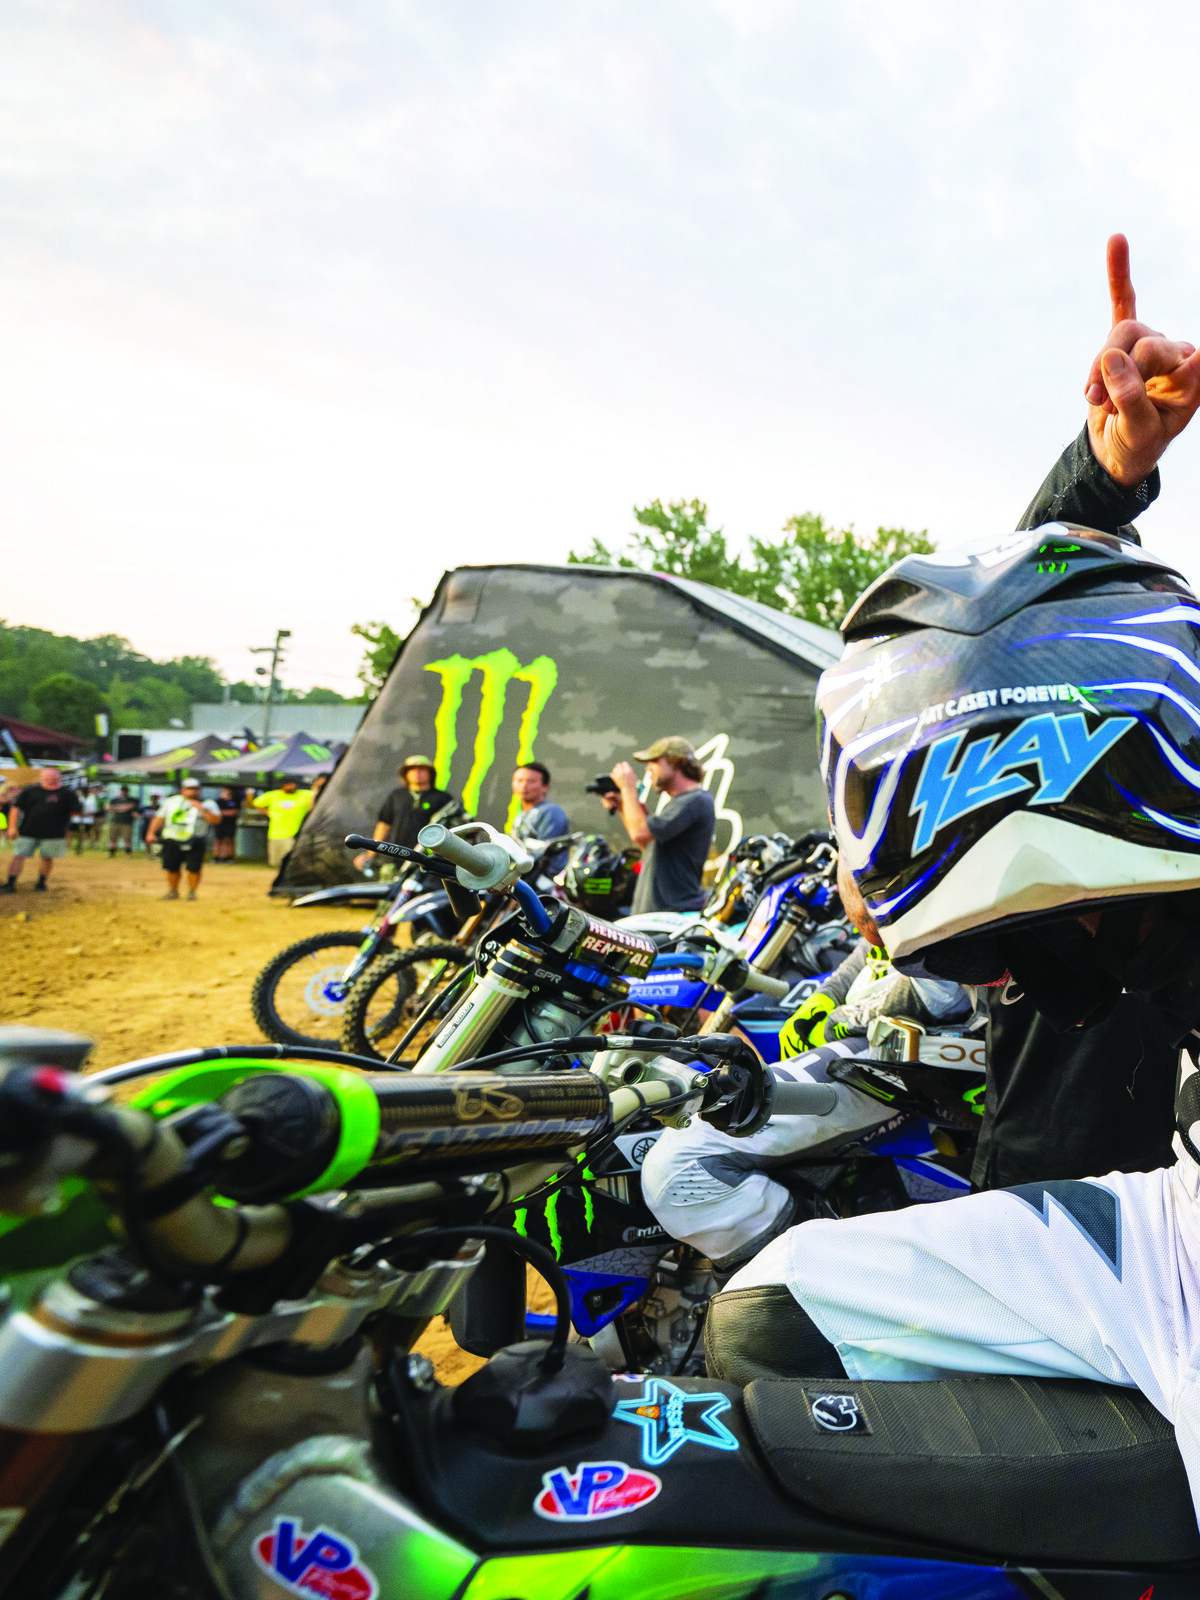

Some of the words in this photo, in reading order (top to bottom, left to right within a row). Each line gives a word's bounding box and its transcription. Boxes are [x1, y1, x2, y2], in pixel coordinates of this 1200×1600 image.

[945, 689, 998, 717] CASEY
[581, 935, 649, 968] RENAL
[589, 920, 654, 953] RENTHAL
[534, 968, 562, 984] GPR
[550, 1465, 625, 1515] VP
[276, 1521, 352, 1583] VP
